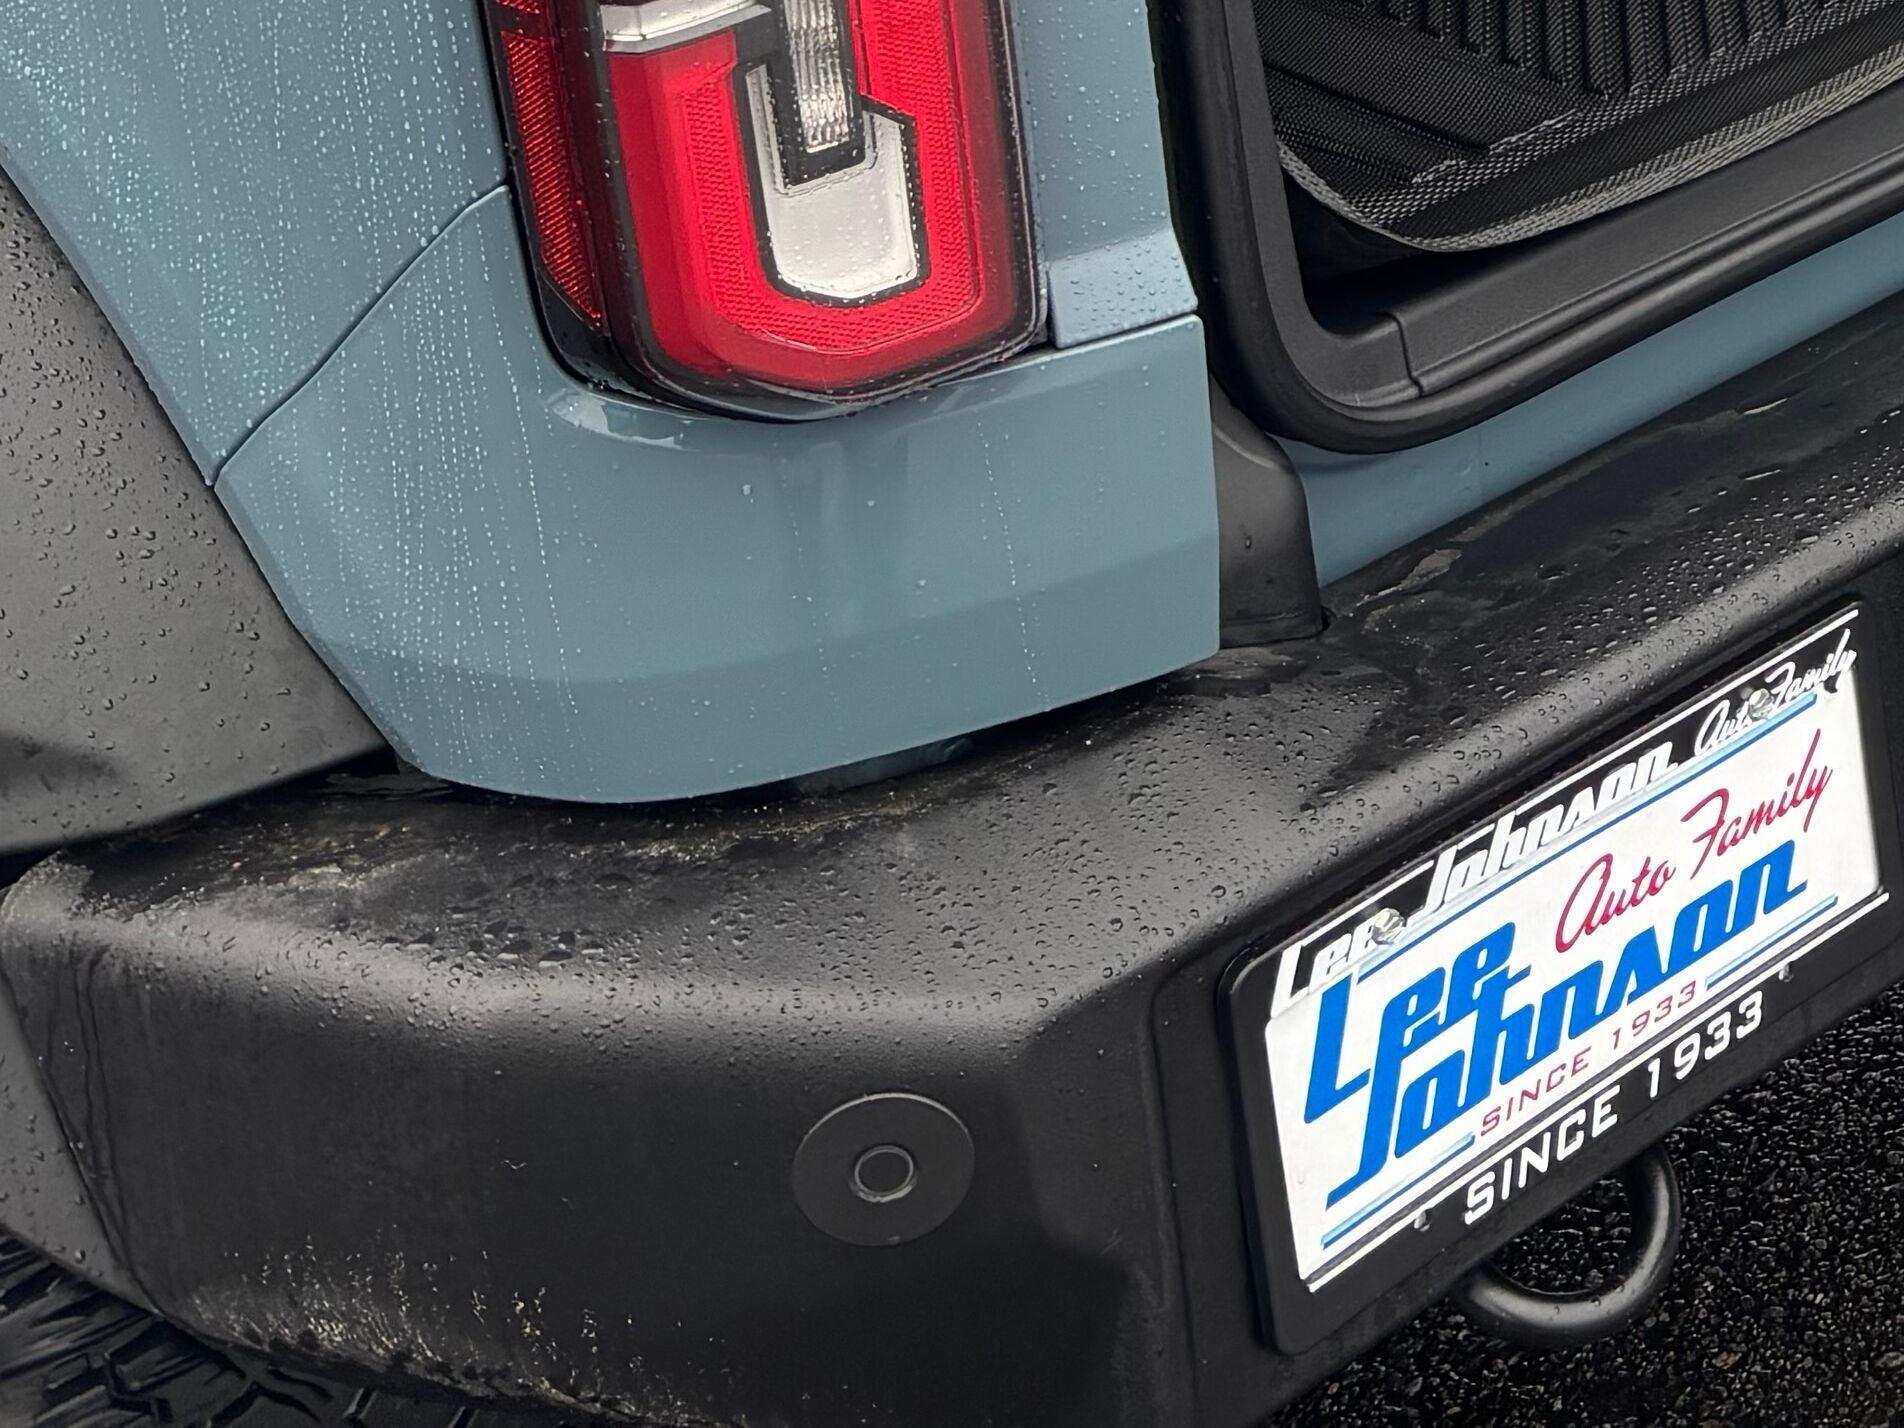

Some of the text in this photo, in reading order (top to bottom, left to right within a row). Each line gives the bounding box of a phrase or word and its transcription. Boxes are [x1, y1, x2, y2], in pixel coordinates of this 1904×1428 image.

[1303, 728, 1833, 1124] Lee Auto Family
[1406, 741, 1678, 929] Johnson
[1694, 699, 1764, 755] Aut
[1765, 628, 1857, 710] Family
[1326, 840, 1807, 1211] Johnson
[1463, 994, 1765, 1226] SINCE 1933
[1478, 978, 1698, 1139] SINCE 1933
